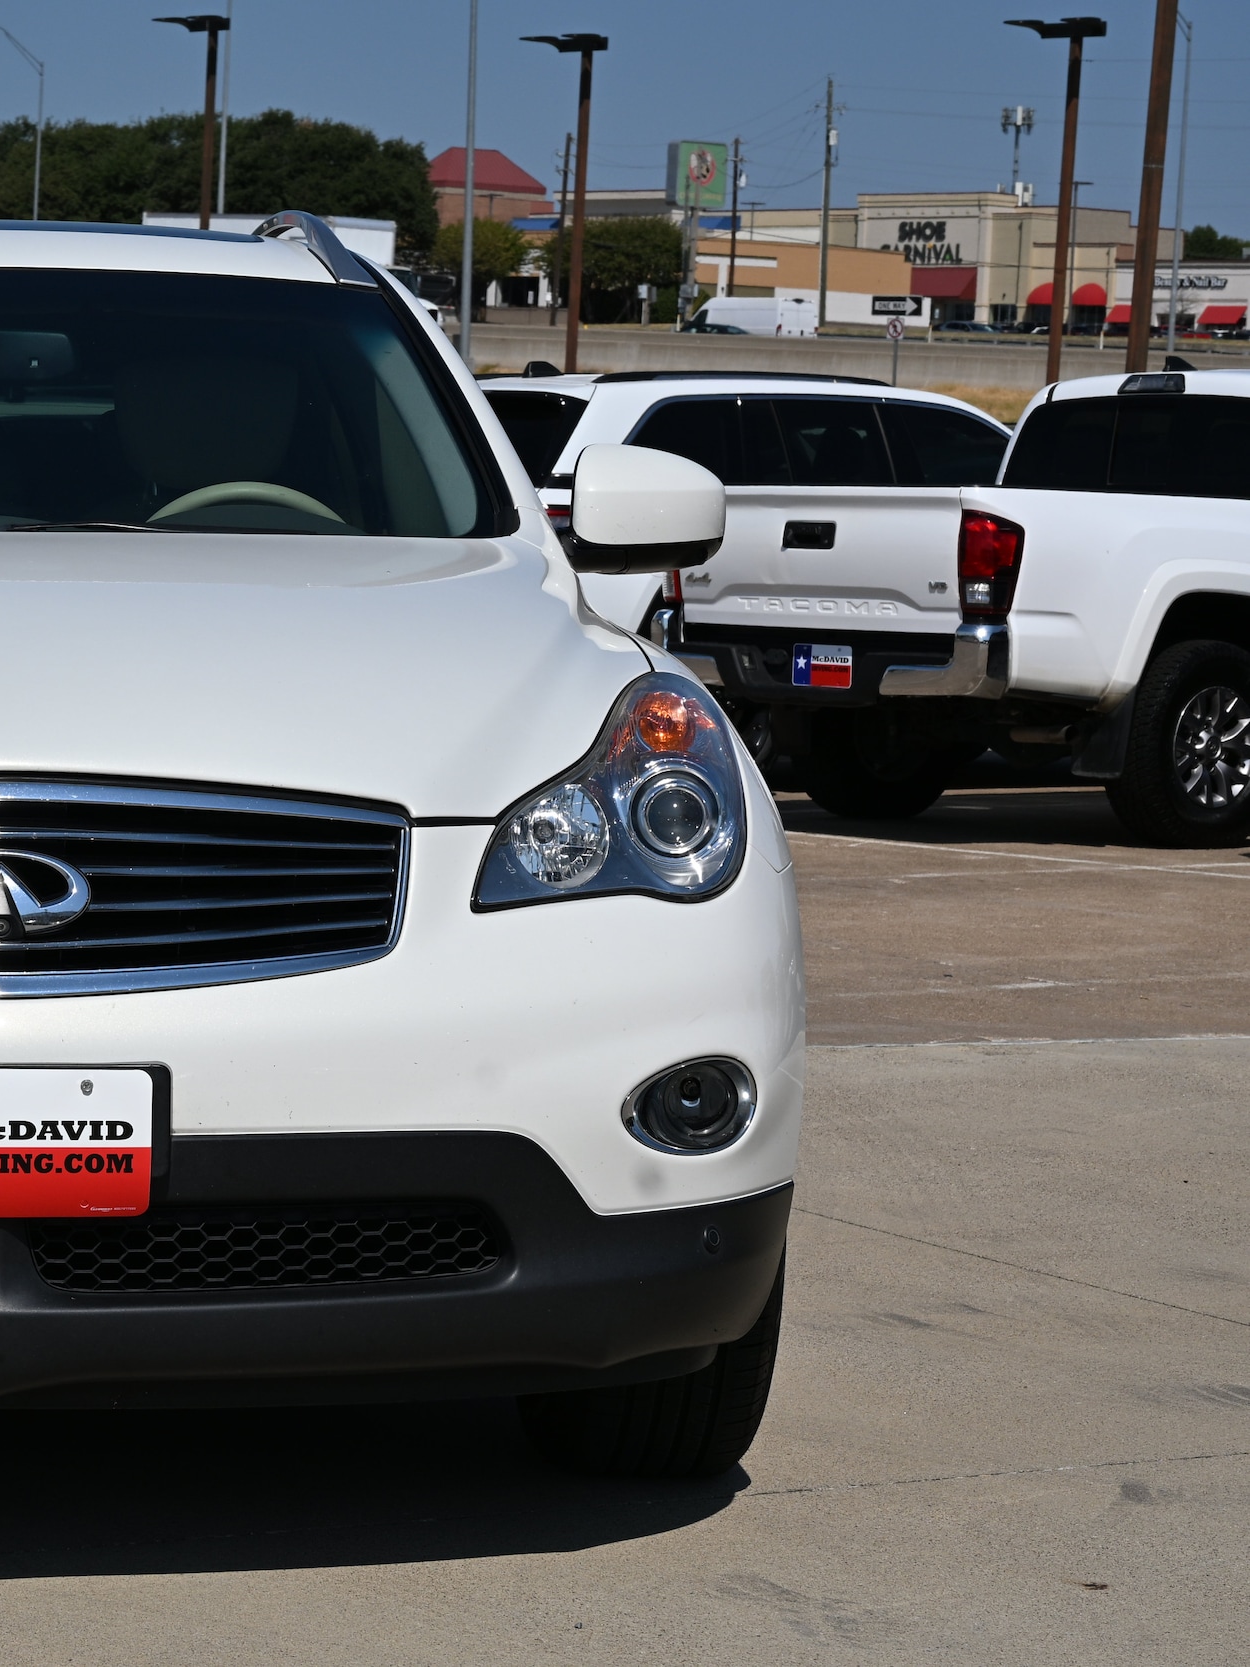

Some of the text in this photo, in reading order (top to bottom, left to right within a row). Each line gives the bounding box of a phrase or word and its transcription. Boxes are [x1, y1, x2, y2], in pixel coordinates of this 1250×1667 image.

[898, 221, 946, 243] SHOE
[881, 243, 963, 265] RNIVAL
[1211, 277, 1227, 288] Bar
[737, 597, 899, 616] TACOMA
